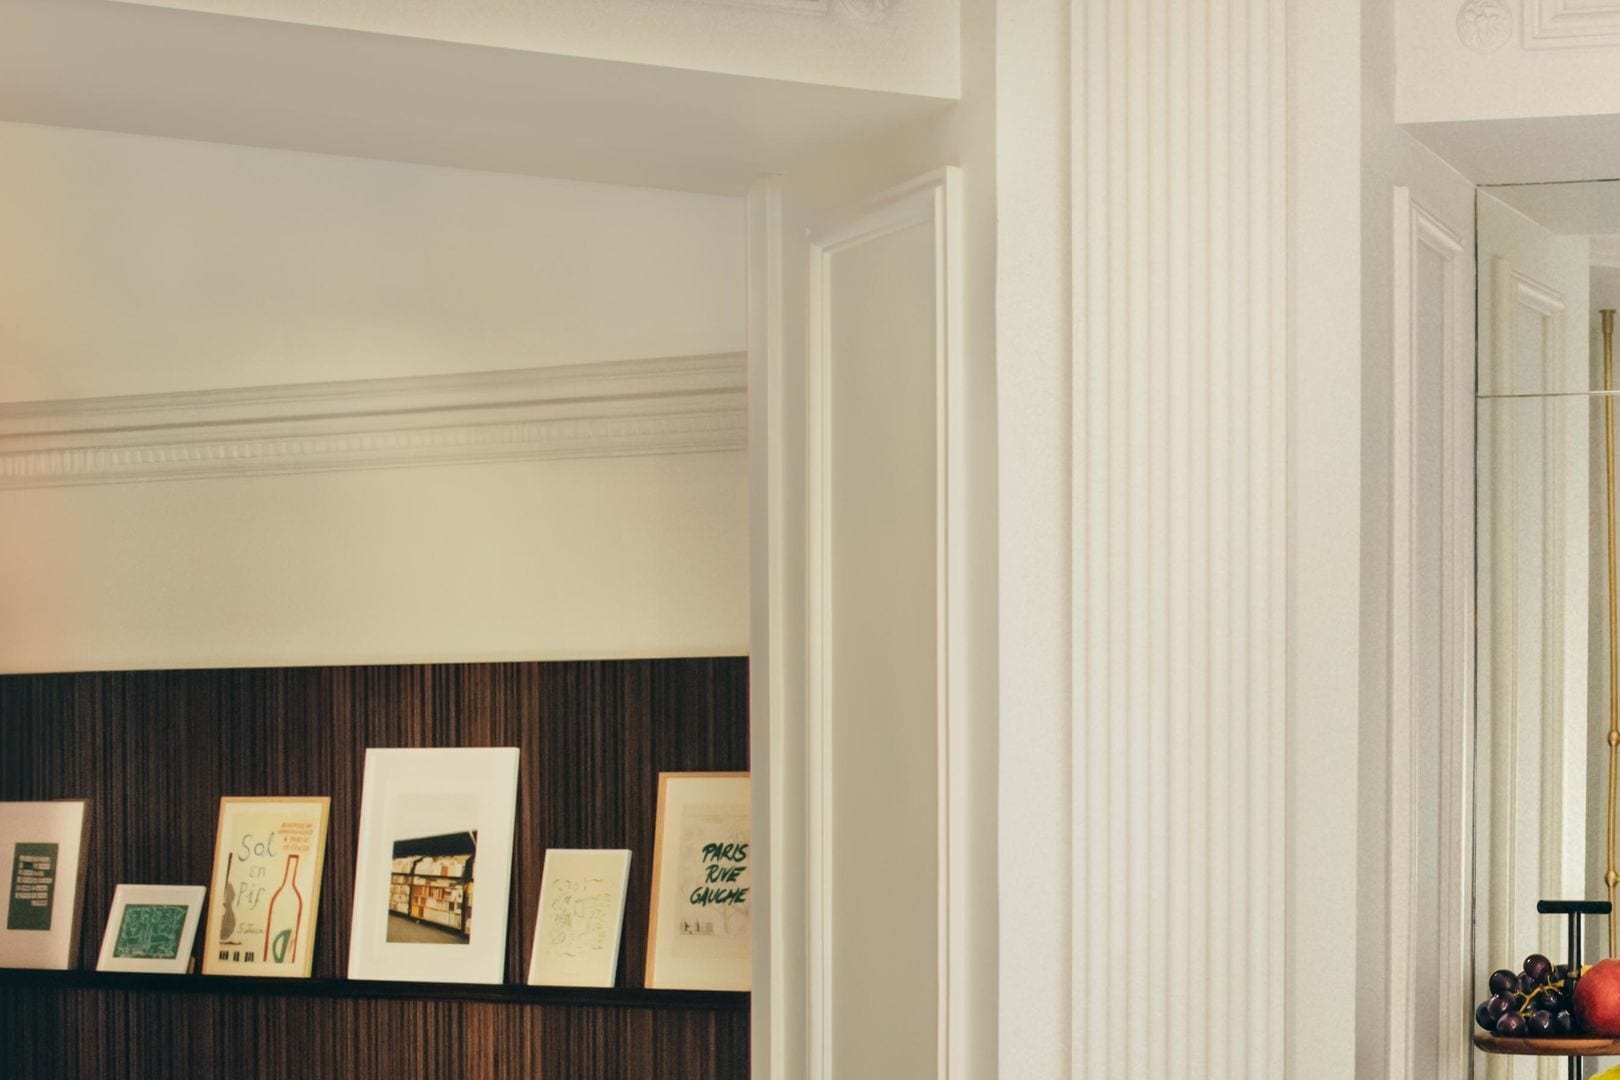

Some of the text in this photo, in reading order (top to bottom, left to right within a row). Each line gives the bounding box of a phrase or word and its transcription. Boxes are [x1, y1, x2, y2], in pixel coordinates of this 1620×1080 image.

[238, 831, 275, 863] Sol
[702, 842, 749, 863] PARIS
[705, 864, 747, 884] RIVE
[690, 886, 750, 907] GAUCHE
